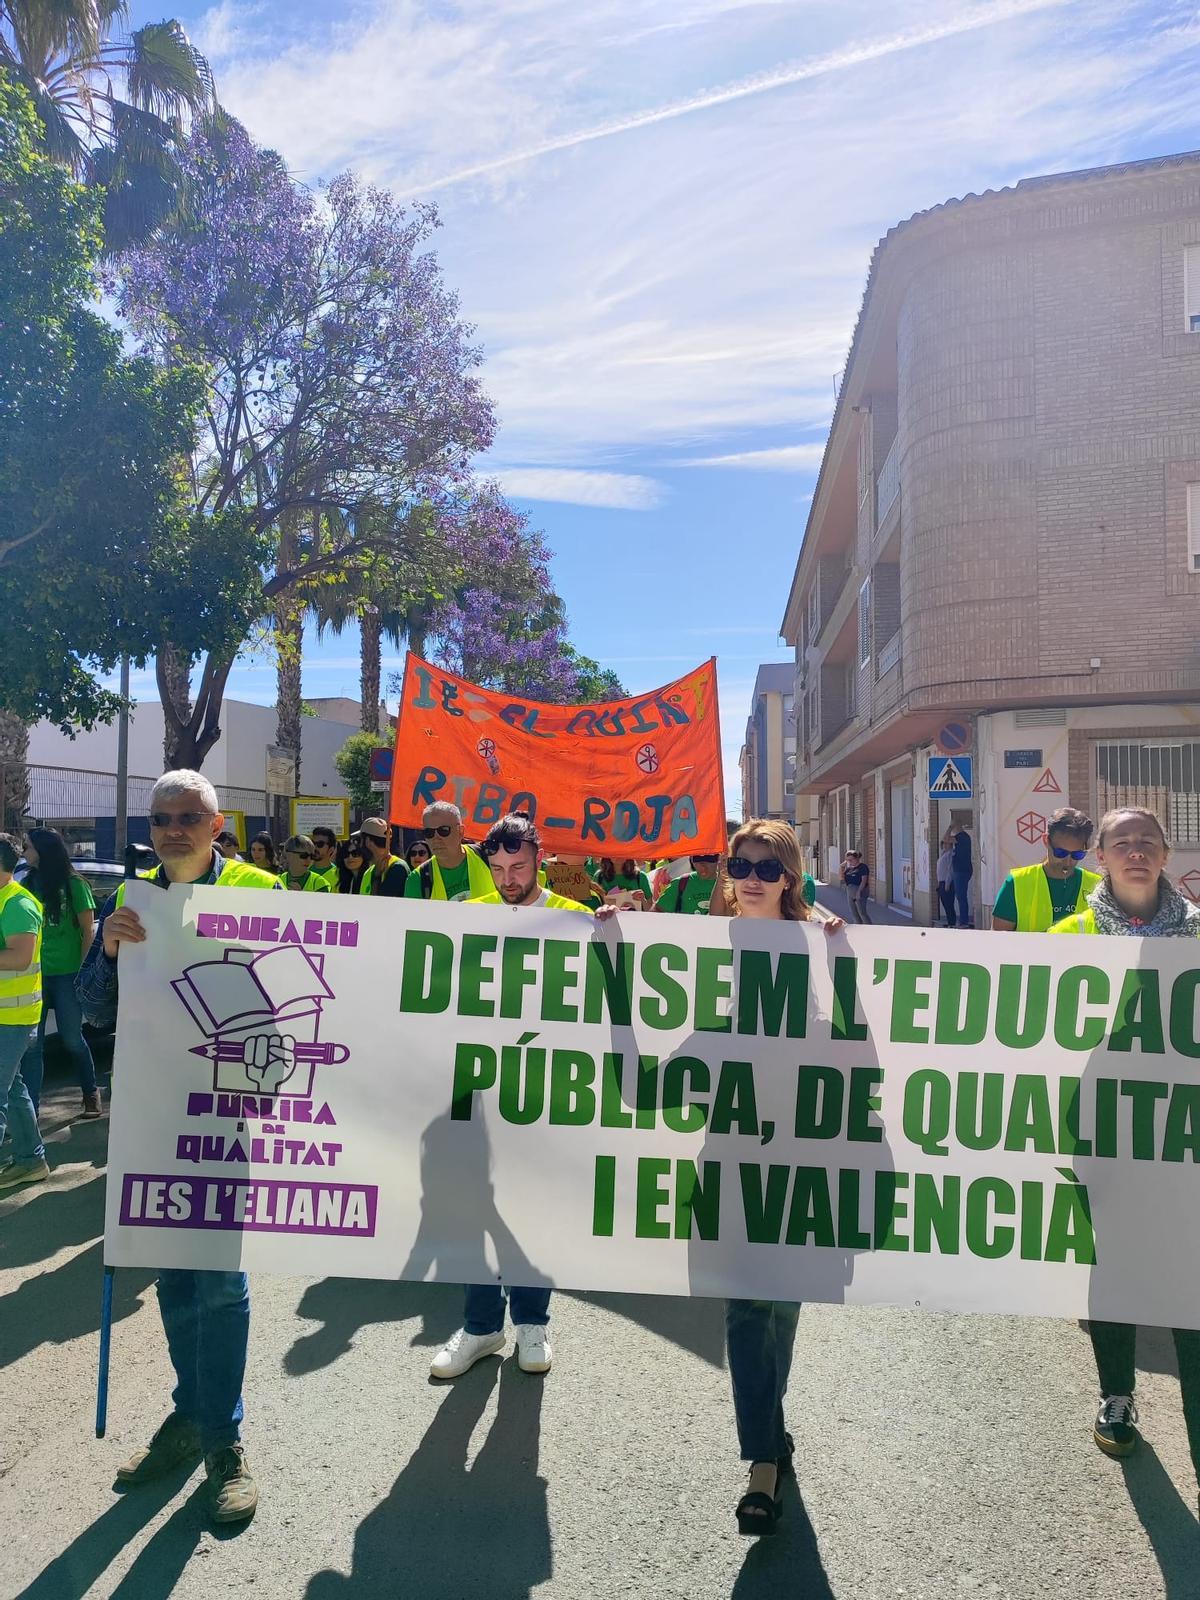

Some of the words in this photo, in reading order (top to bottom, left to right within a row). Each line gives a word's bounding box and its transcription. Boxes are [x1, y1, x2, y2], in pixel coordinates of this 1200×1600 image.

[401, 930, 809, 1039] DEFENSEM
[451, 1032, 775, 1146] PÚBLICA,
[795, 1065, 885, 1143] DE
[903, 1069, 1200, 1164] QUALITA
[129, 1180, 193, 1221] IES
[204, 1184, 369, 1229] L'ELIANA
[592, 1155, 616, 1237] I
[636, 1157, 721, 1240] EN
[739, 1164, 1097, 1265] VALENCIÀ
